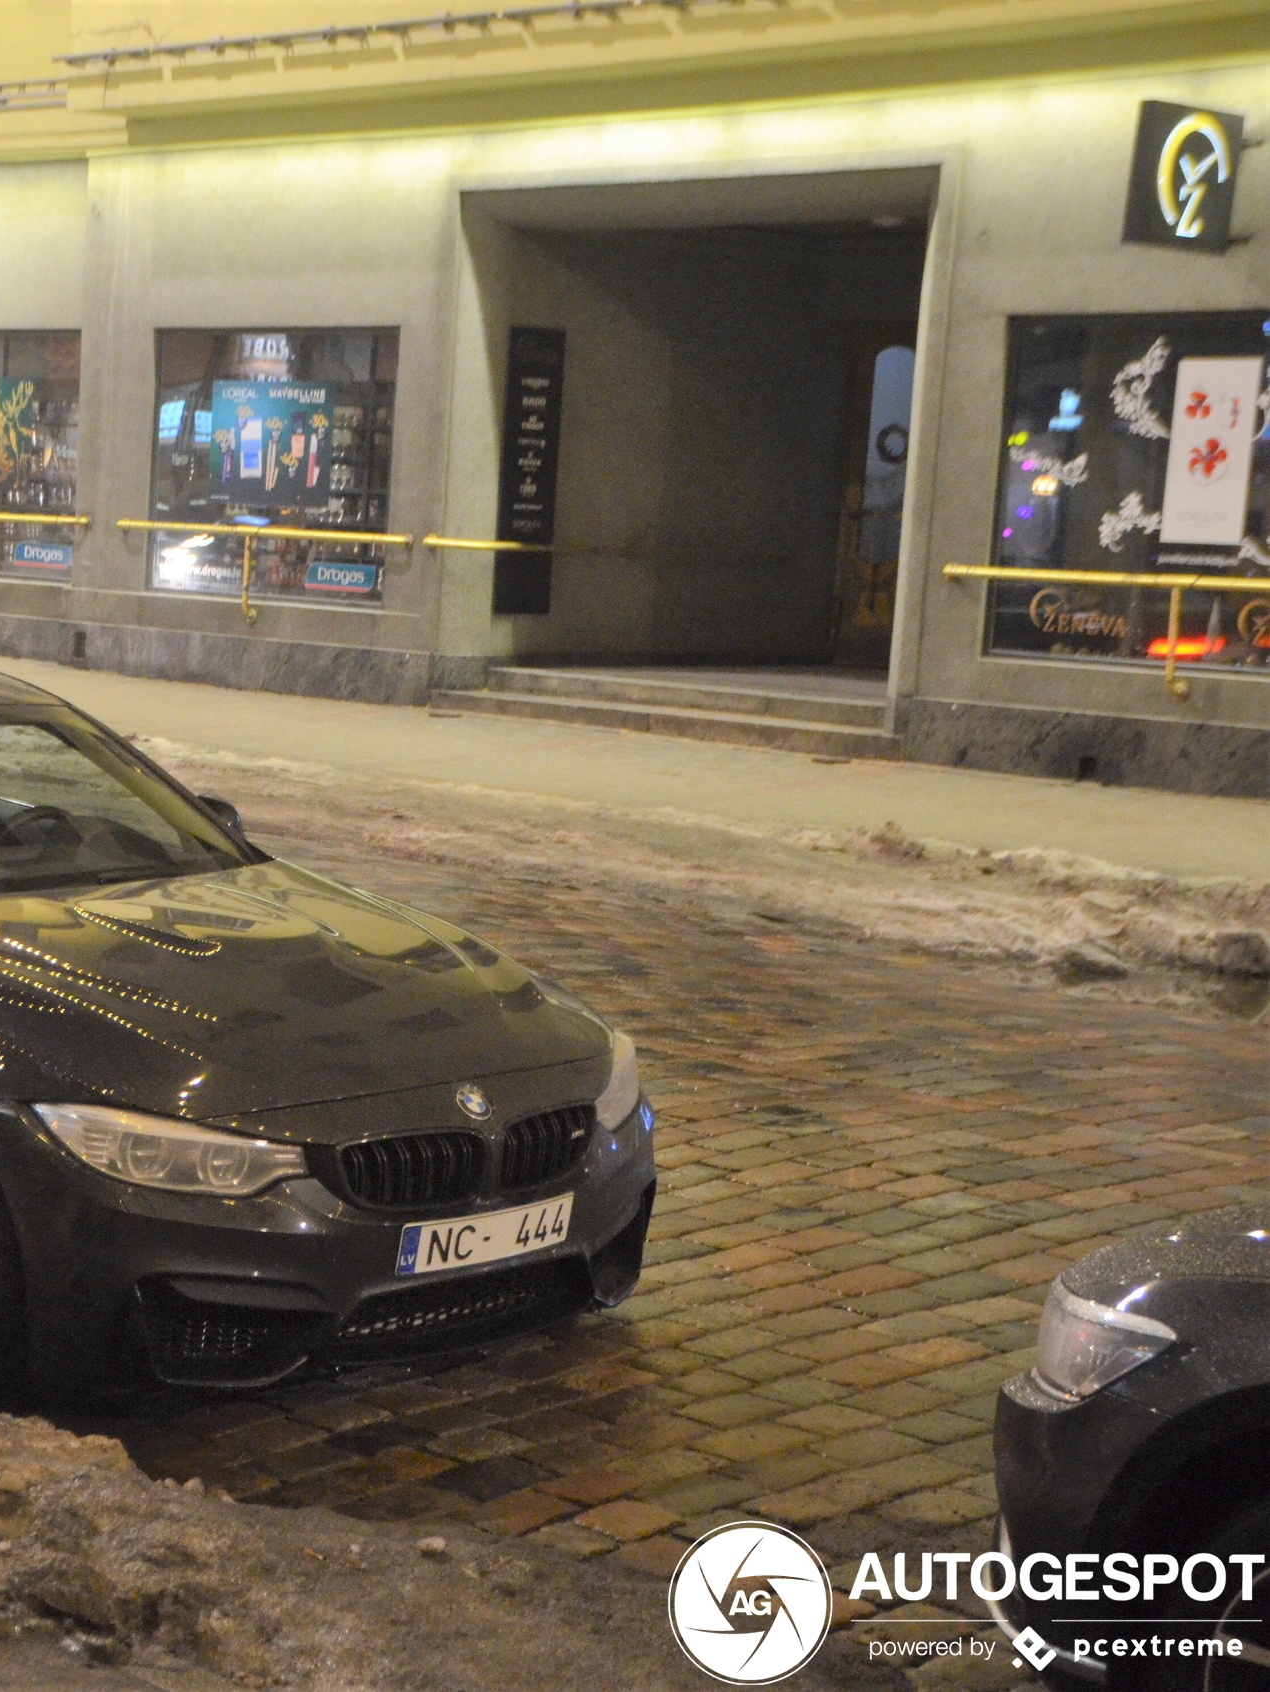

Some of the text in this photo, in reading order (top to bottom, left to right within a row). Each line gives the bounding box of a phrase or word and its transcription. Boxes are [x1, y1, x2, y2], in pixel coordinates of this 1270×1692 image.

[23, 545, 64, 563] Drogas
[317, 566, 365, 585] Drogas
[515, 1204, 565, 1247] 444
[400, 1252, 417, 1267] LV
